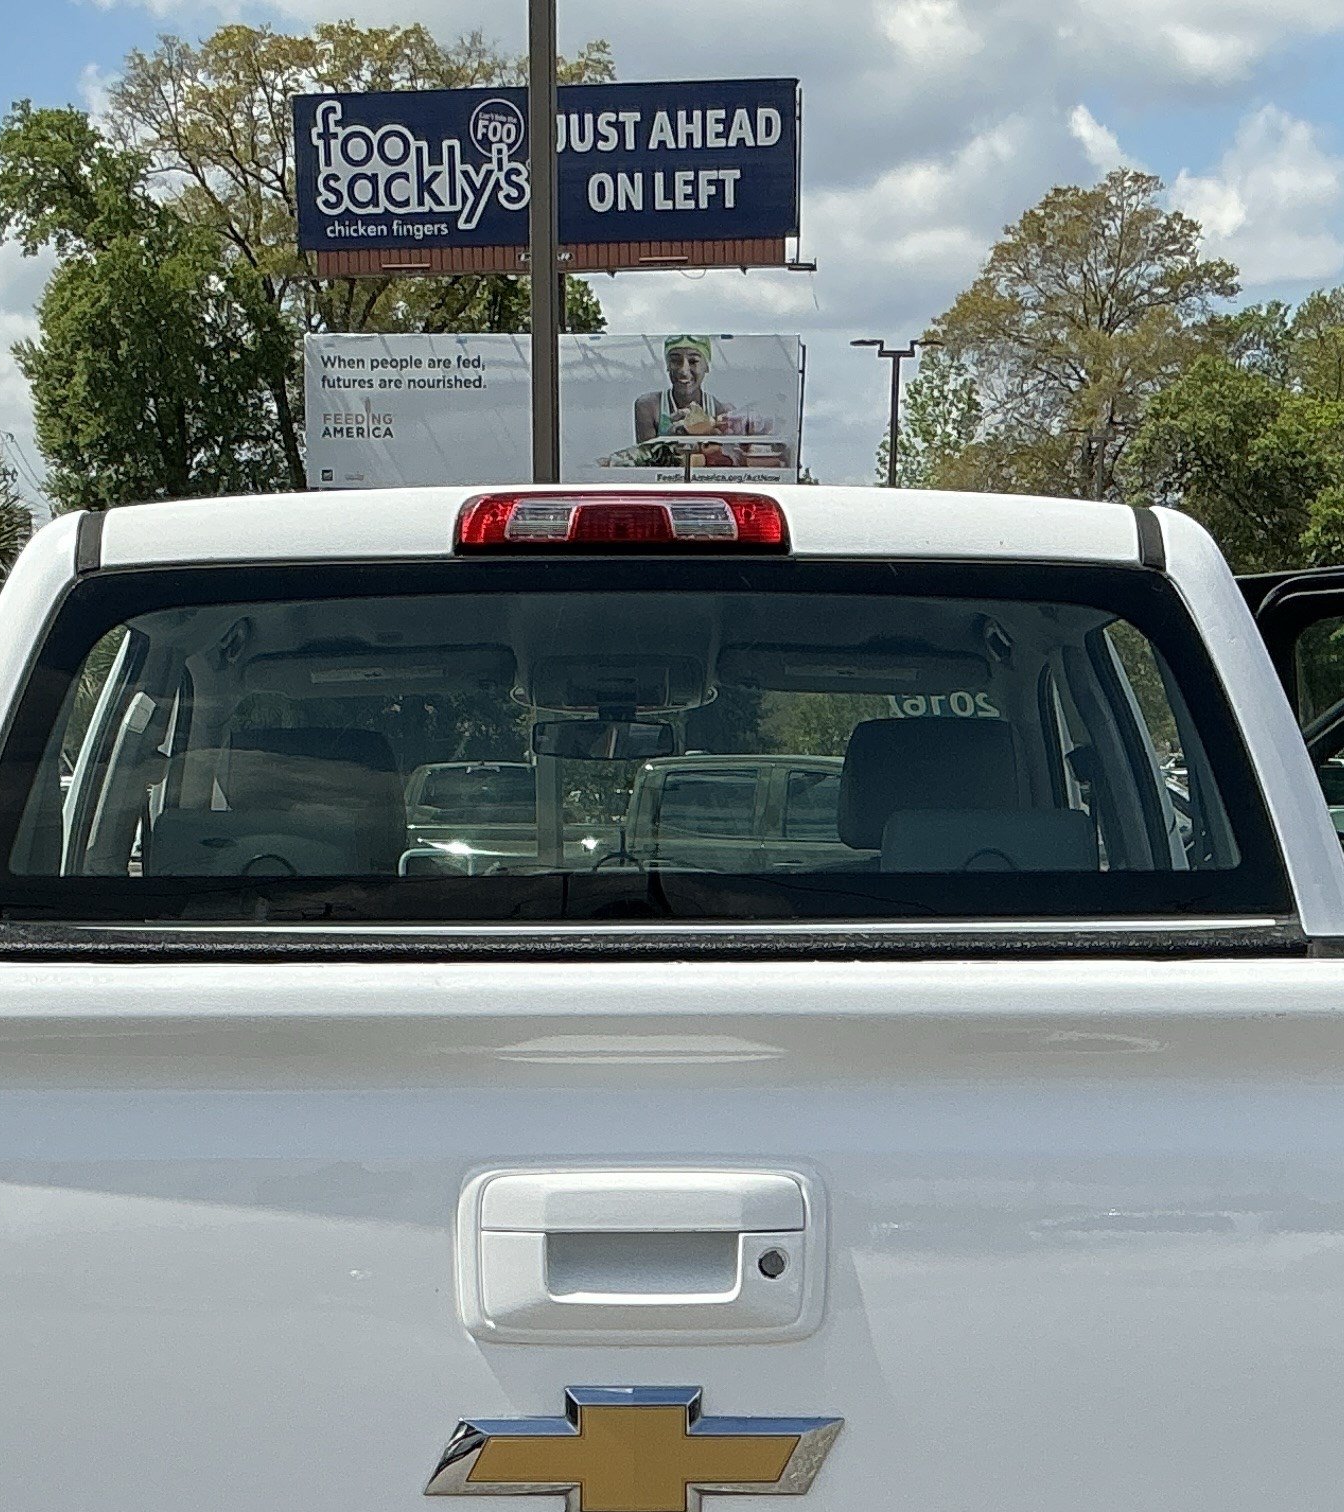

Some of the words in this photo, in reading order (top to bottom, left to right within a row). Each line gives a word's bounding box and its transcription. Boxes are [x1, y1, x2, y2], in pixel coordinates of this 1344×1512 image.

[313, 102, 413, 169] foo
[477, 120, 516, 143] FOO
[556, 111, 642, 153] JUST
[649, 107, 782, 149] AHEAD
[317, 139, 530, 229] sackly's
[588, 172, 645, 212] ON
[653, 169, 742, 210] LEFT
[326, 220, 387, 237] chicken
[392, 220, 449, 239] fingers
[321, 355, 366, 369] When
[370, 355, 423, 371] people
[427, 357, 453, 369] are
[457, 354, 486, 371] fed,
[321, 375, 374, 389] futures
[378, 378, 403, 389] are
[408, 375, 487, 389] nourished.
[321, 426, 394, 439] AMERICA
